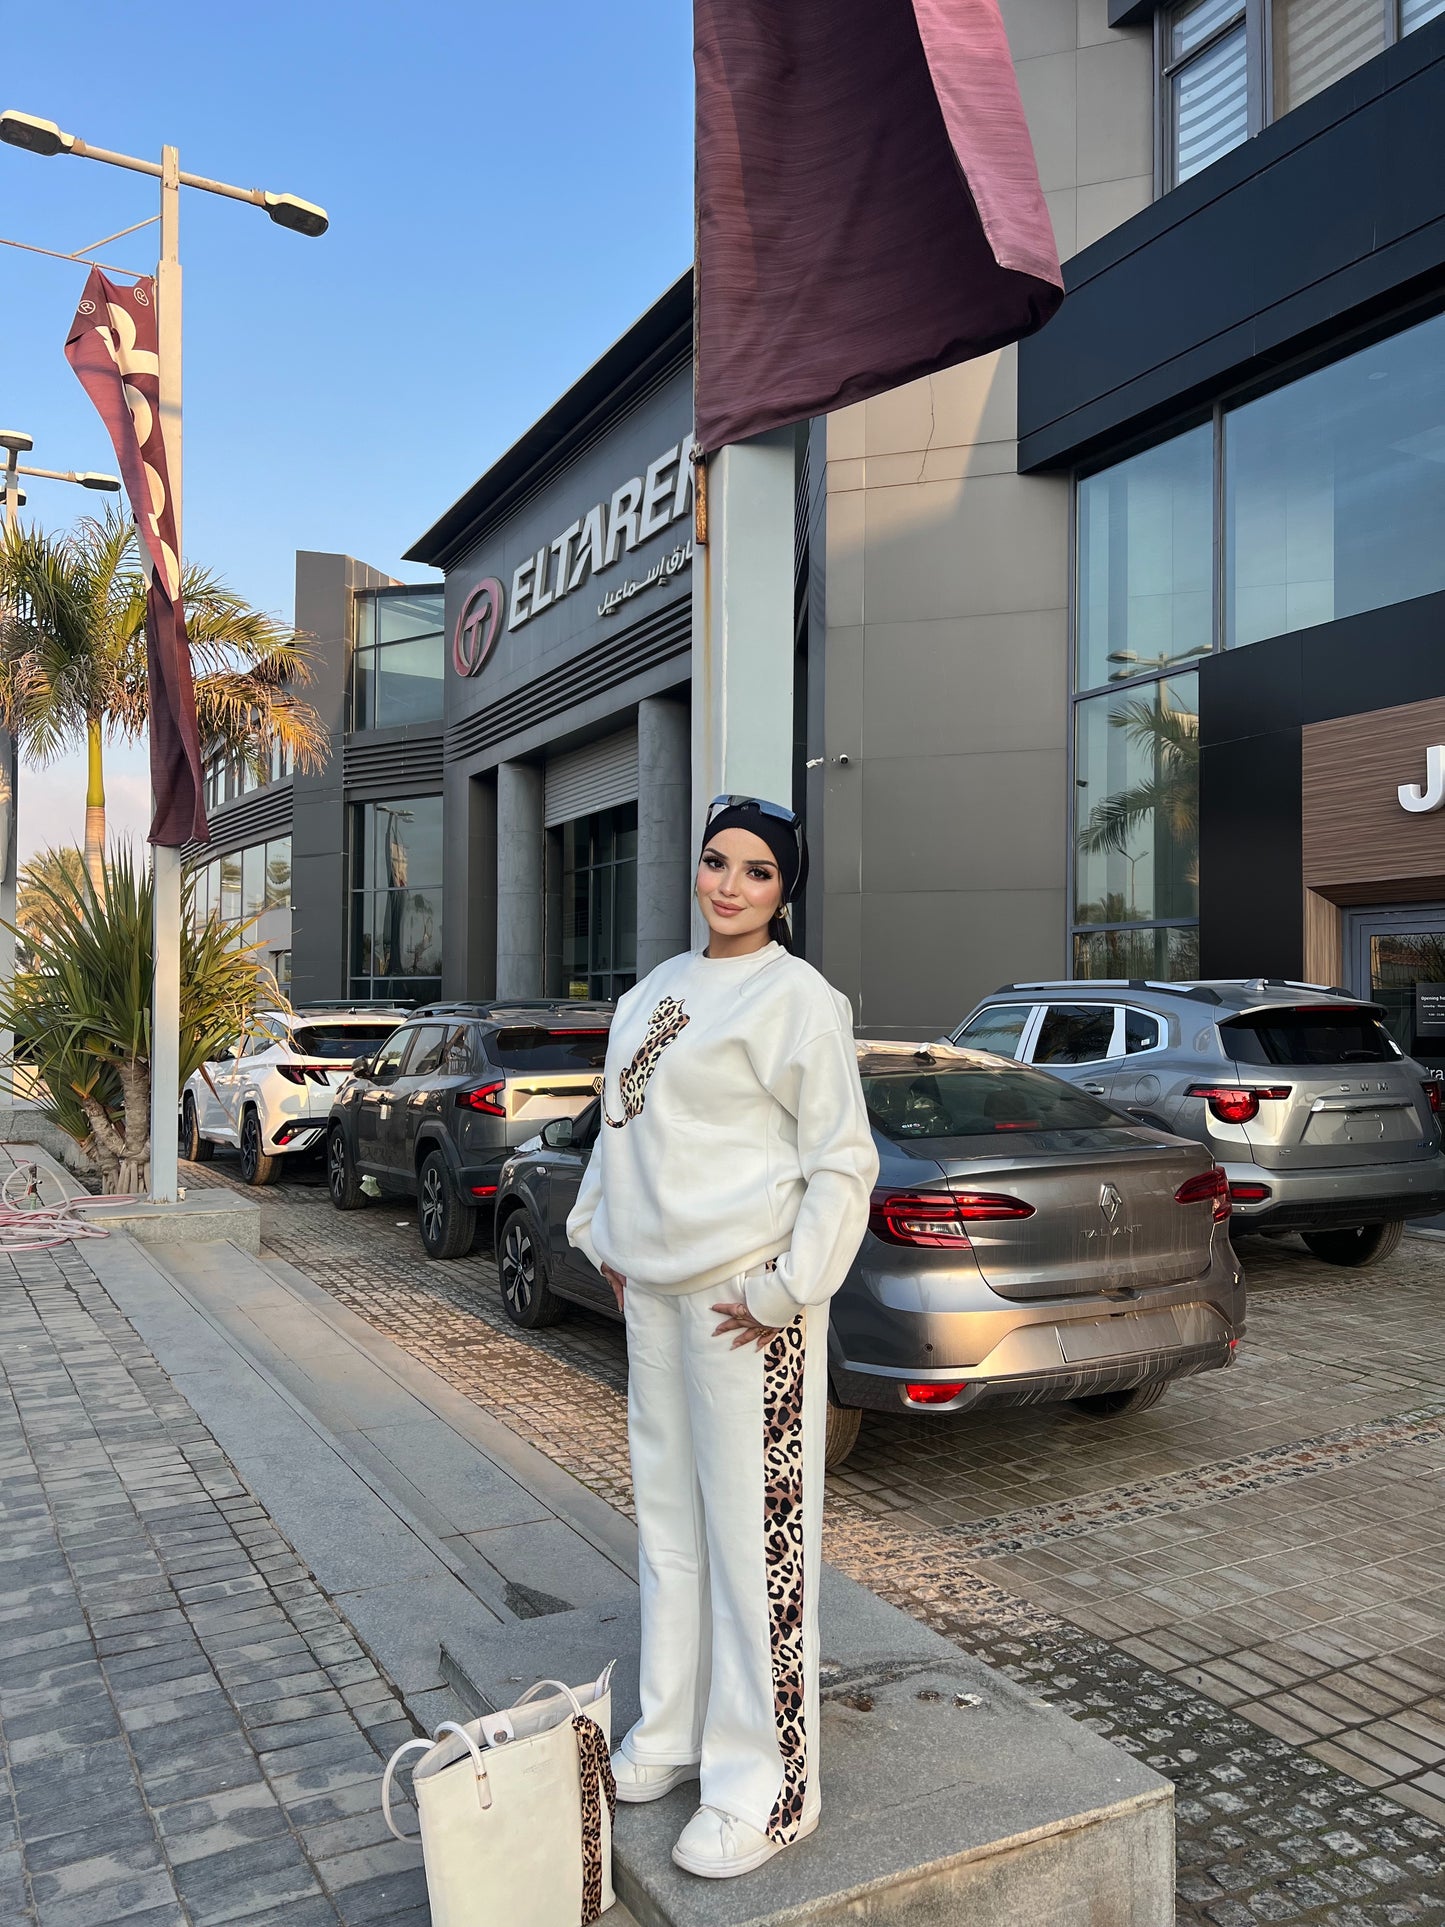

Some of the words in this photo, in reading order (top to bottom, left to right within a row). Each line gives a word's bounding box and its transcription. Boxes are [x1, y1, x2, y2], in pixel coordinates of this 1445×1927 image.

[666, 539, 693, 575] ارق
[597, 556, 668, 617] إسماعيل
[1080, 1224, 1142, 1239] TALANT
